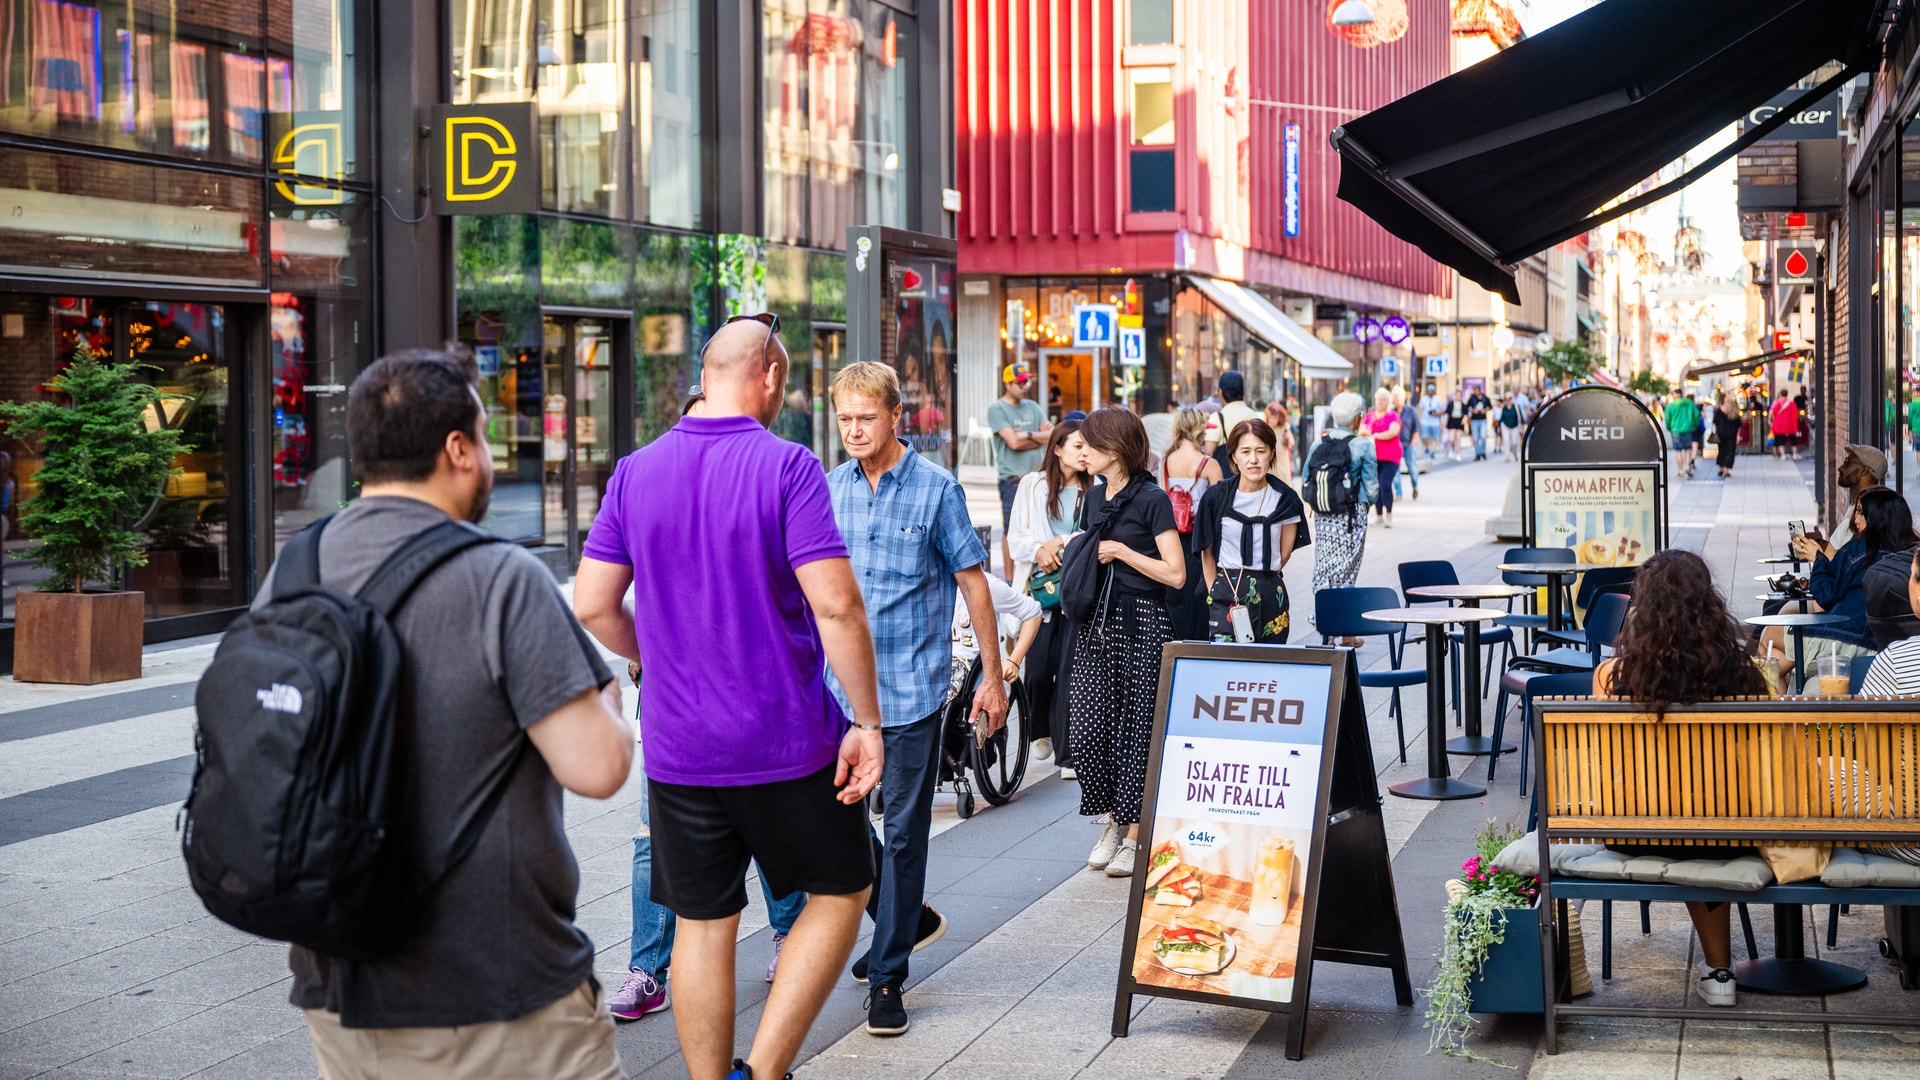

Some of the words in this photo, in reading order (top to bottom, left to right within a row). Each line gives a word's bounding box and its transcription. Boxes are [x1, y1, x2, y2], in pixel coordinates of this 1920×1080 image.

[1749, 106, 1832, 125] Gter
[1560, 426, 1625, 441] NERO
[1544, 477, 1645, 494] SOMMARFIKA
[1226, 680, 1278, 693] CAFFÈ
[1192, 693, 1305, 726] NERO
[1187, 760, 1250, 784] ISLATTE
[1258, 765, 1291, 787] TILL
[1186, 782, 1216, 803] DIN
[1222, 785, 1285, 809] FRALLA
[1188, 831, 1216, 843] 64kr
